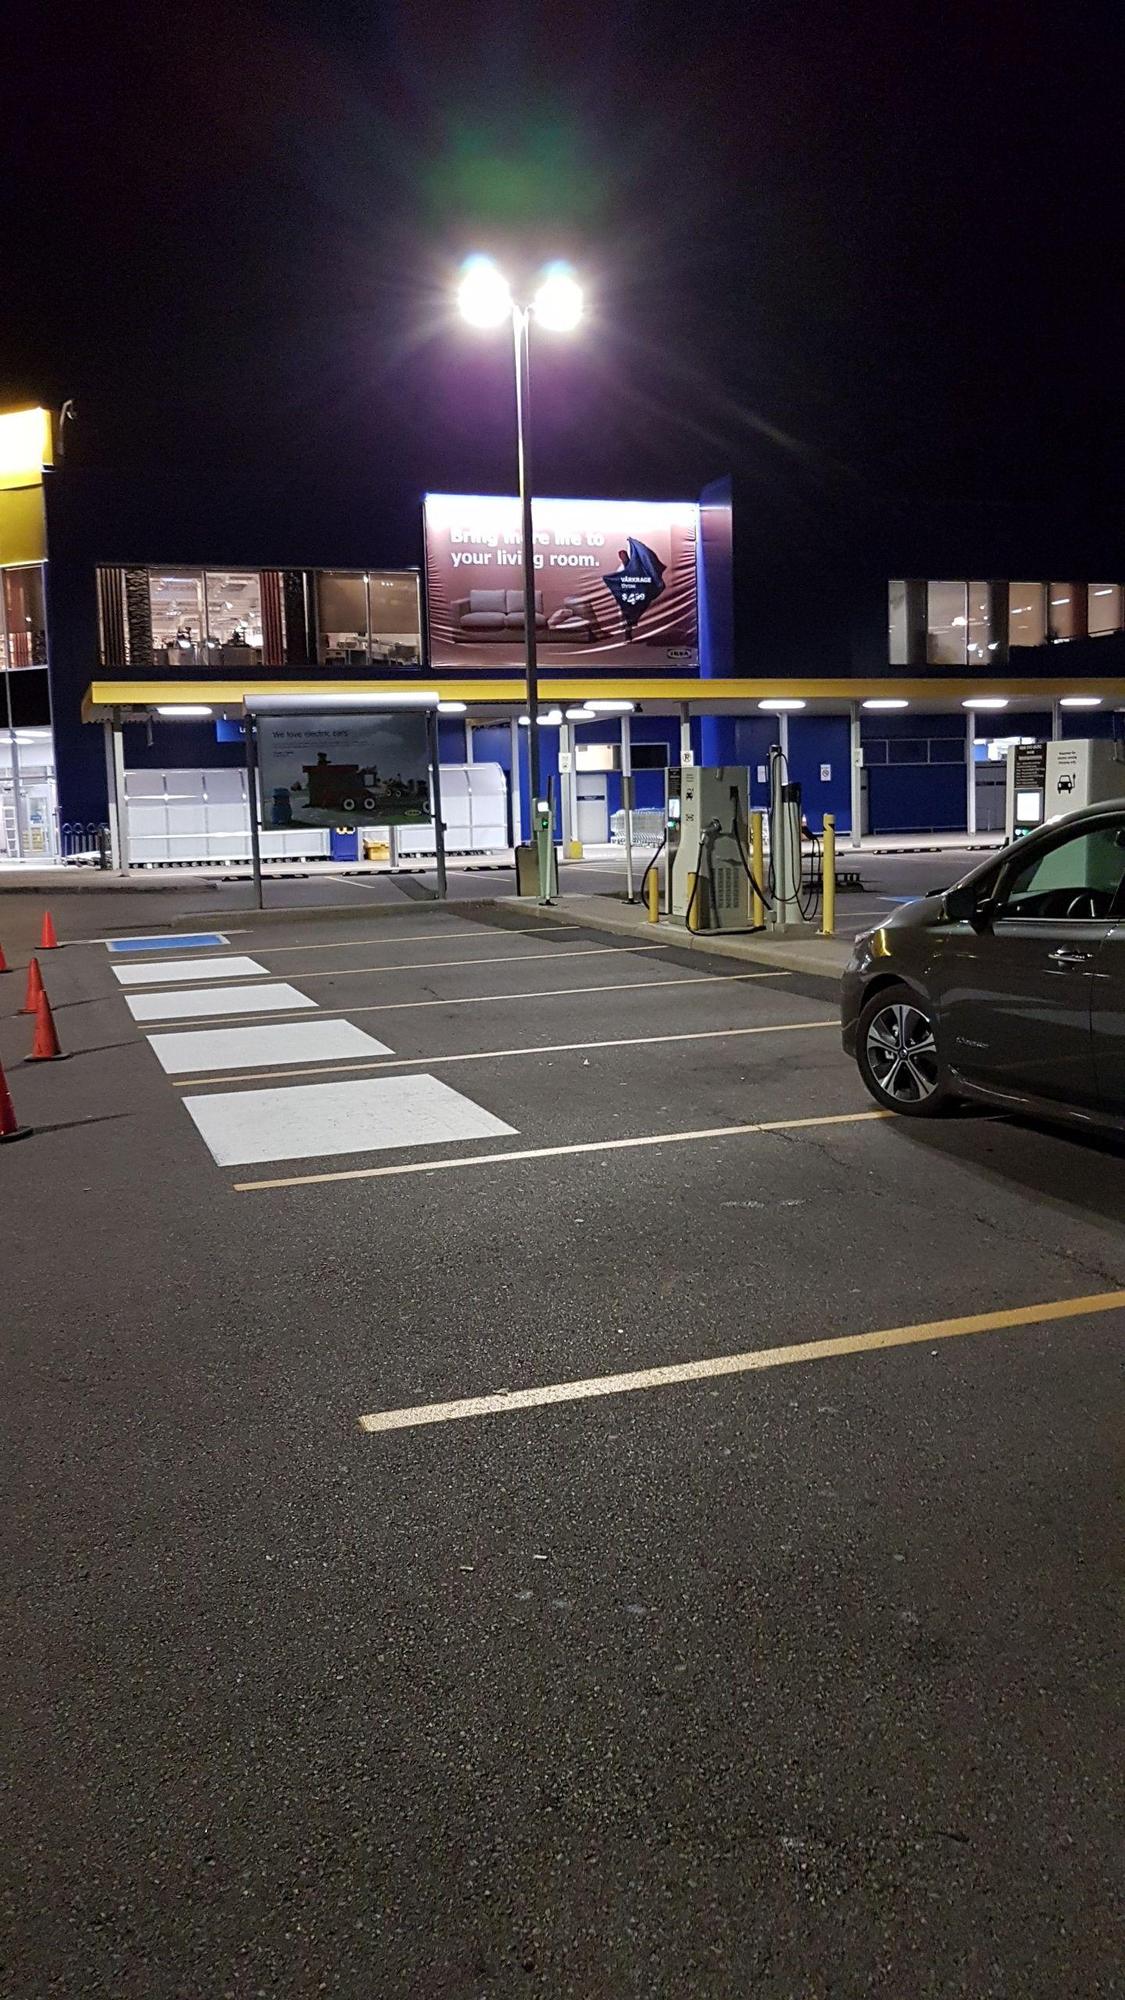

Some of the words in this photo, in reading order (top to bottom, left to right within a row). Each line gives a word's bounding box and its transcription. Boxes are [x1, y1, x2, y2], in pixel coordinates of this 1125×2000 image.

[450, 529, 498, 547] Bring
[503, 530, 550, 546] mre
[586, 530, 605, 547] to
[451, 551, 493, 568] your
[497, 550, 544, 569] livig
[550, 552, 601, 568] room.
